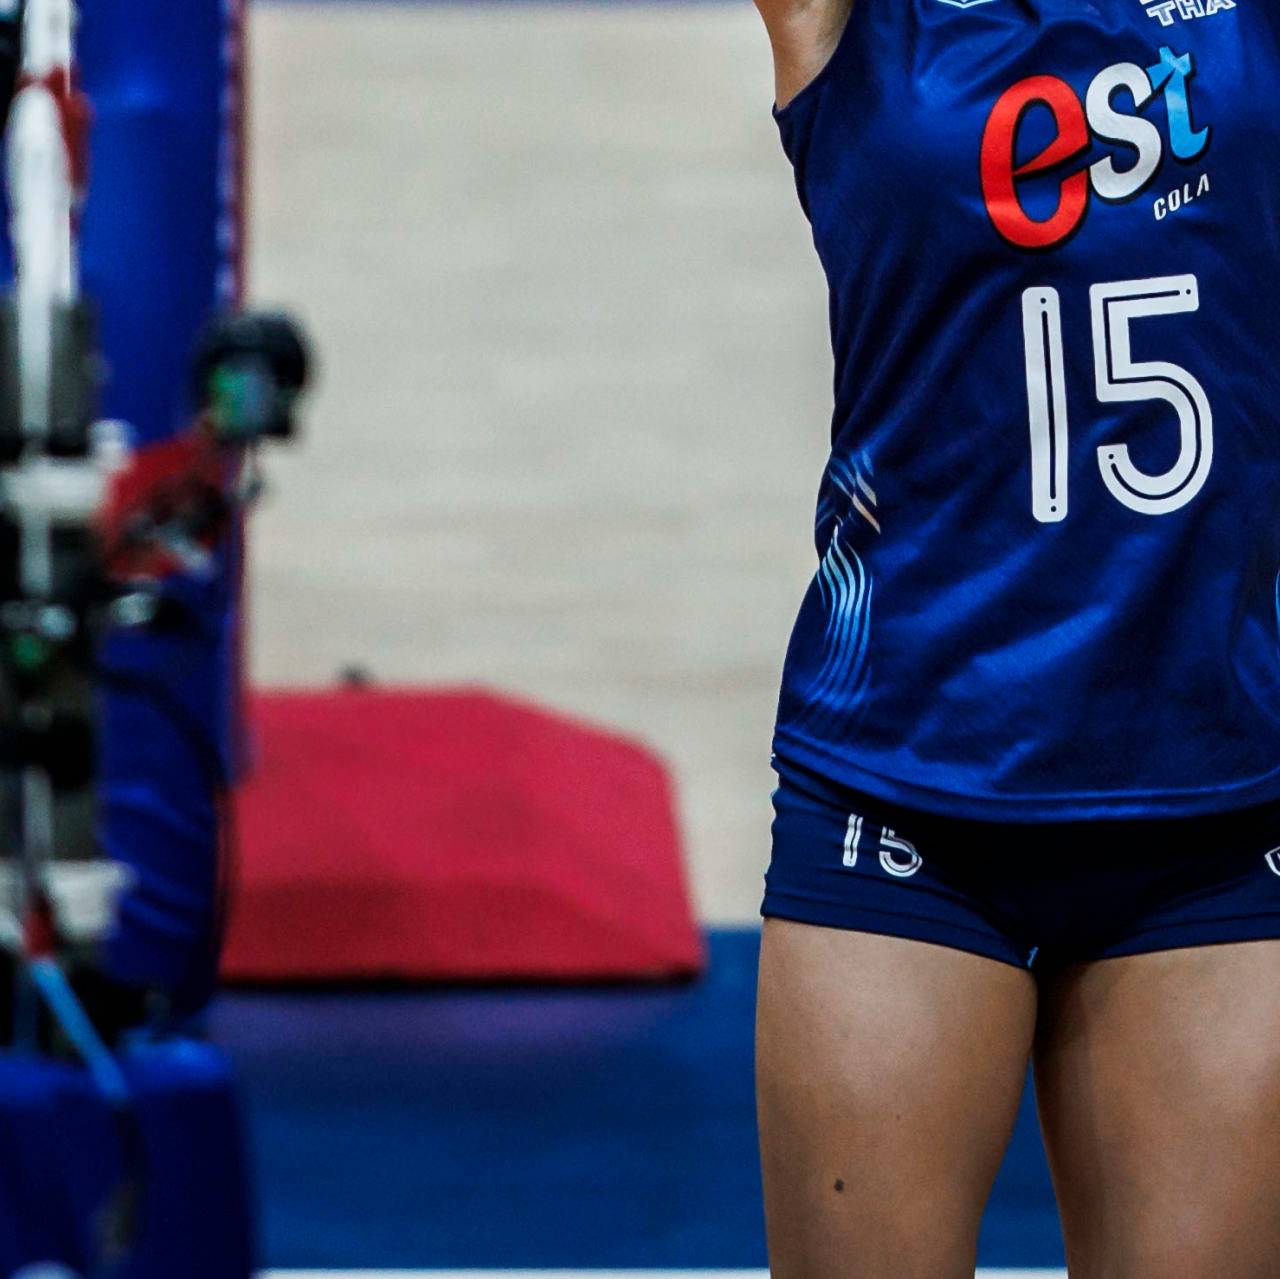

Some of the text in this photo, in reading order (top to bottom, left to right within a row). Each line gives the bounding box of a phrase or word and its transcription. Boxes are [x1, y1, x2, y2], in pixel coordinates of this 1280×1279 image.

[980, 45, 1212, 248] est
[1153, 173, 1210, 221] COLA
[1021, 273, 1214, 523] 15
[842, 812, 923, 877] 15
